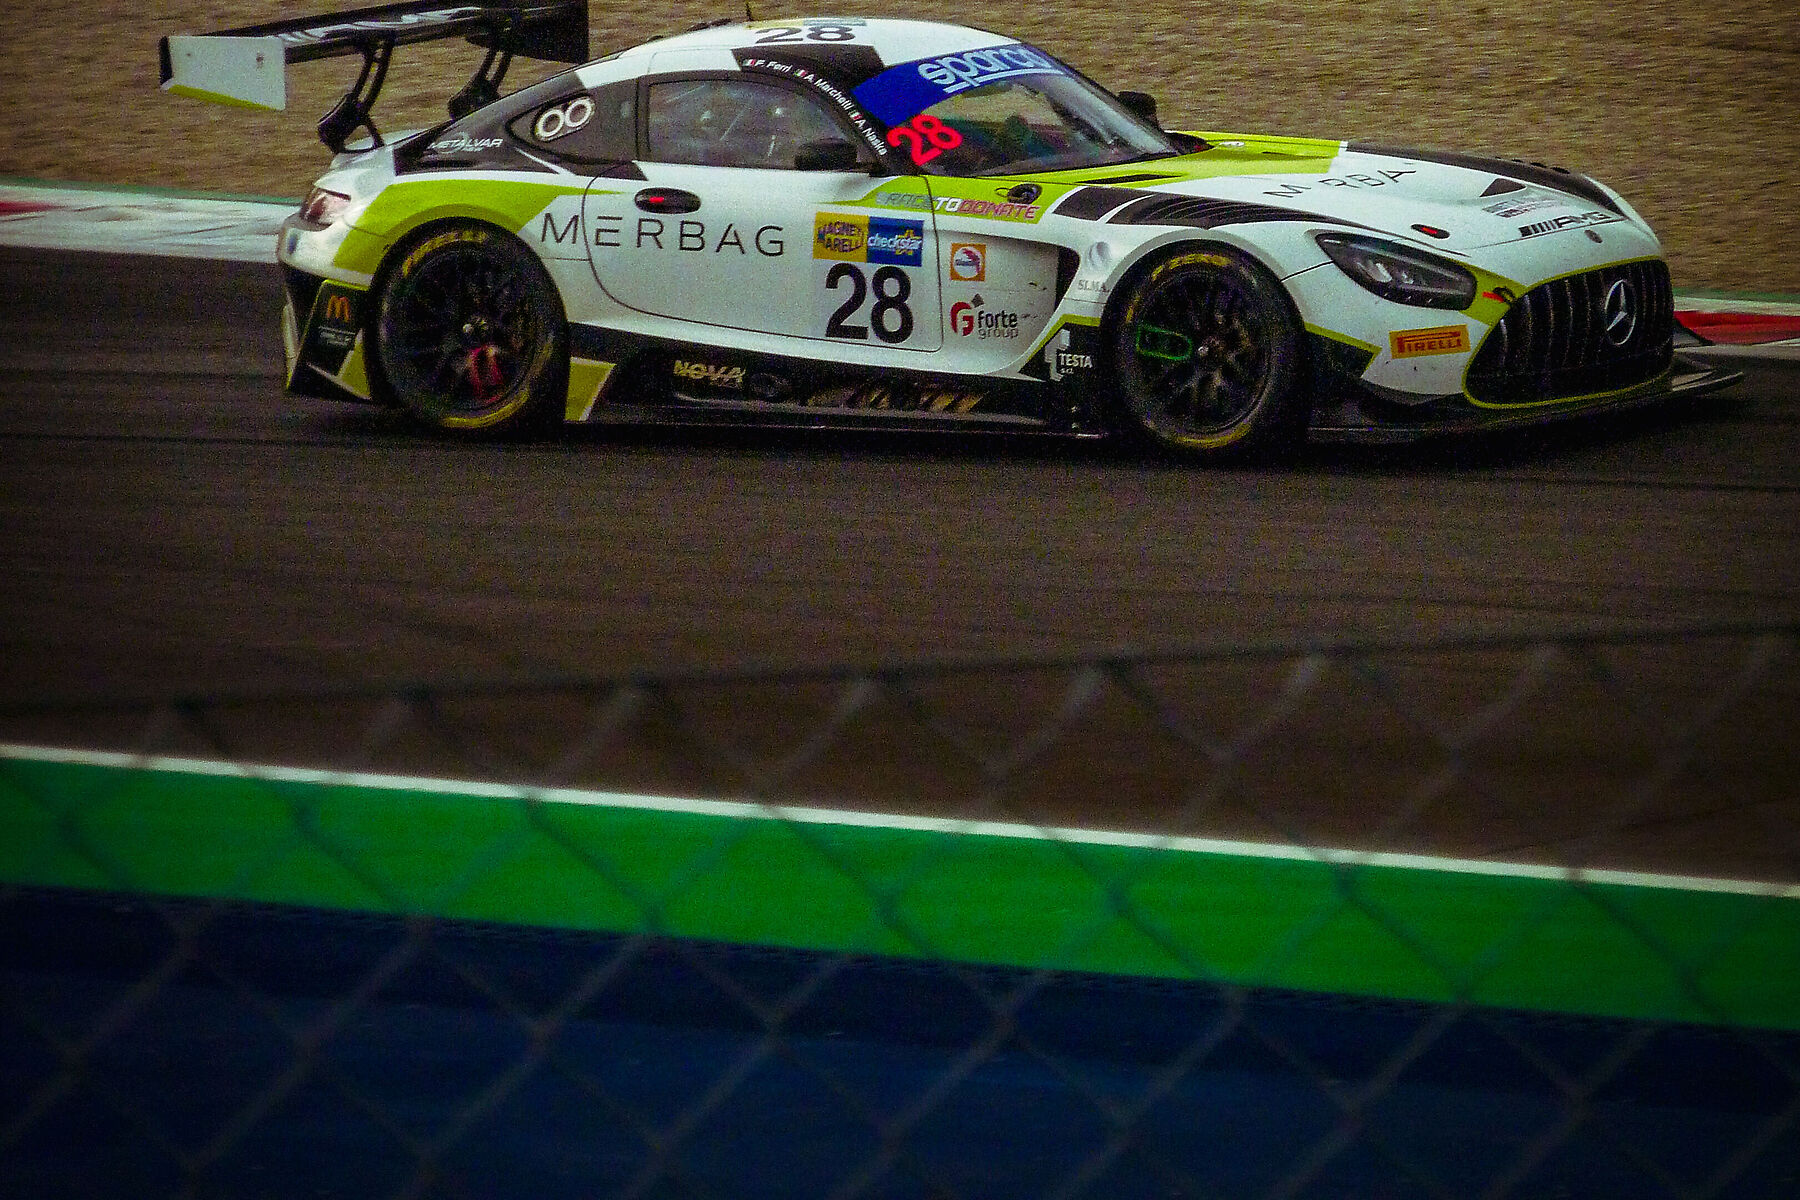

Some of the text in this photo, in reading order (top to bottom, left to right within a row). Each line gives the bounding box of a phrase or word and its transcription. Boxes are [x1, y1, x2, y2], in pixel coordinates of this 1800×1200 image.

[755, 25, 856, 44] 28
[918, 46, 1053, 89] sparco
[887, 114, 964, 166] 28
[541, 213, 785, 257] MERBAG
[825, 262, 914, 344] 28
[978, 310, 1018, 328] forte
[978, 328, 1019, 340] group
[1397, 331, 1462, 353] PIRELLI
[1058, 353, 1093, 369] TESTA
